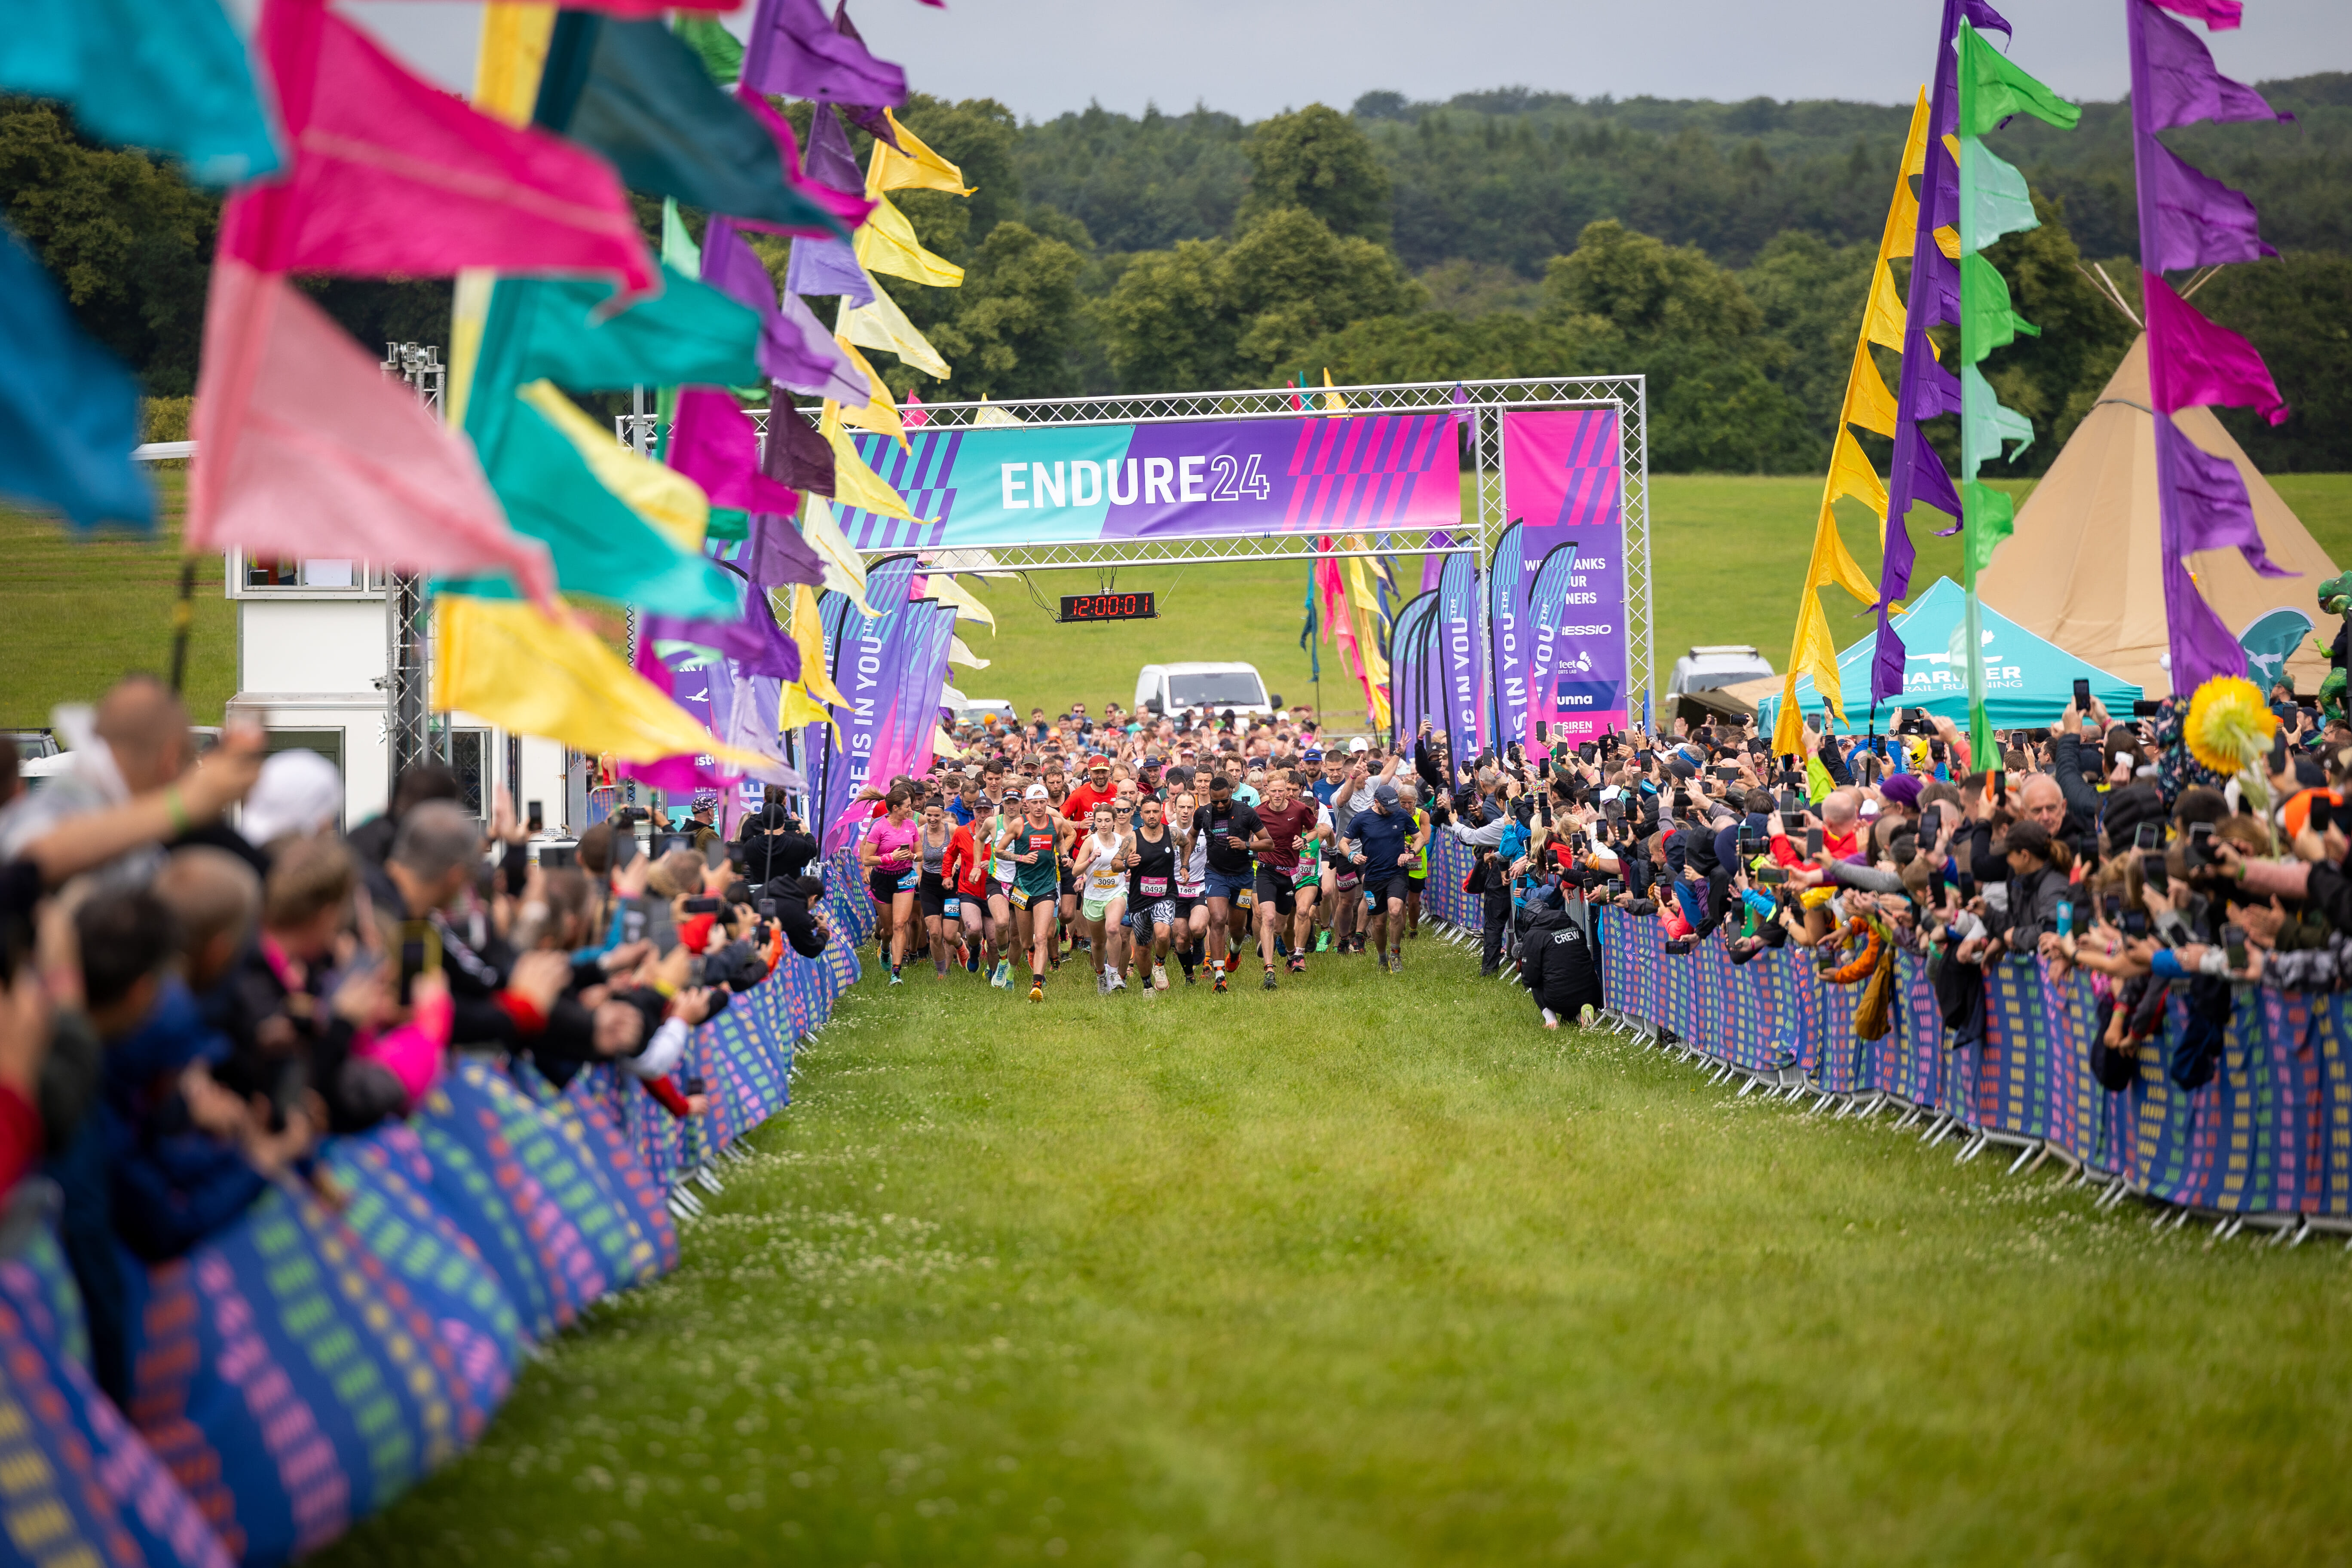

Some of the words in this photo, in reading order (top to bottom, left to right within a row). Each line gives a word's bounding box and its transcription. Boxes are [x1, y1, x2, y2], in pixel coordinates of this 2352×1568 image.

[1001, 454, 1270, 509] ENDURE24
[1573, 558, 1605, 570] ANKS
[1565, 592, 1597, 604] NERS
[1074, 595, 1148, 616] 12:00:01
[1562, 625, 1611, 636] RESSIO
[1559, 660, 1577, 669] feet
[1456, 676, 1472, 701] IN
[1504, 677, 1528, 706] IN
[1557, 695, 1592, 704] unna
[854, 698, 875, 726] IN
[1563, 721, 1592, 730] SIREN
[852, 733, 872, 758] IS
[1011, 894, 1026, 907] 3074
[1551, 927, 1575, 937] THRESHOLD
[1554, 931, 1580, 944] CREW
